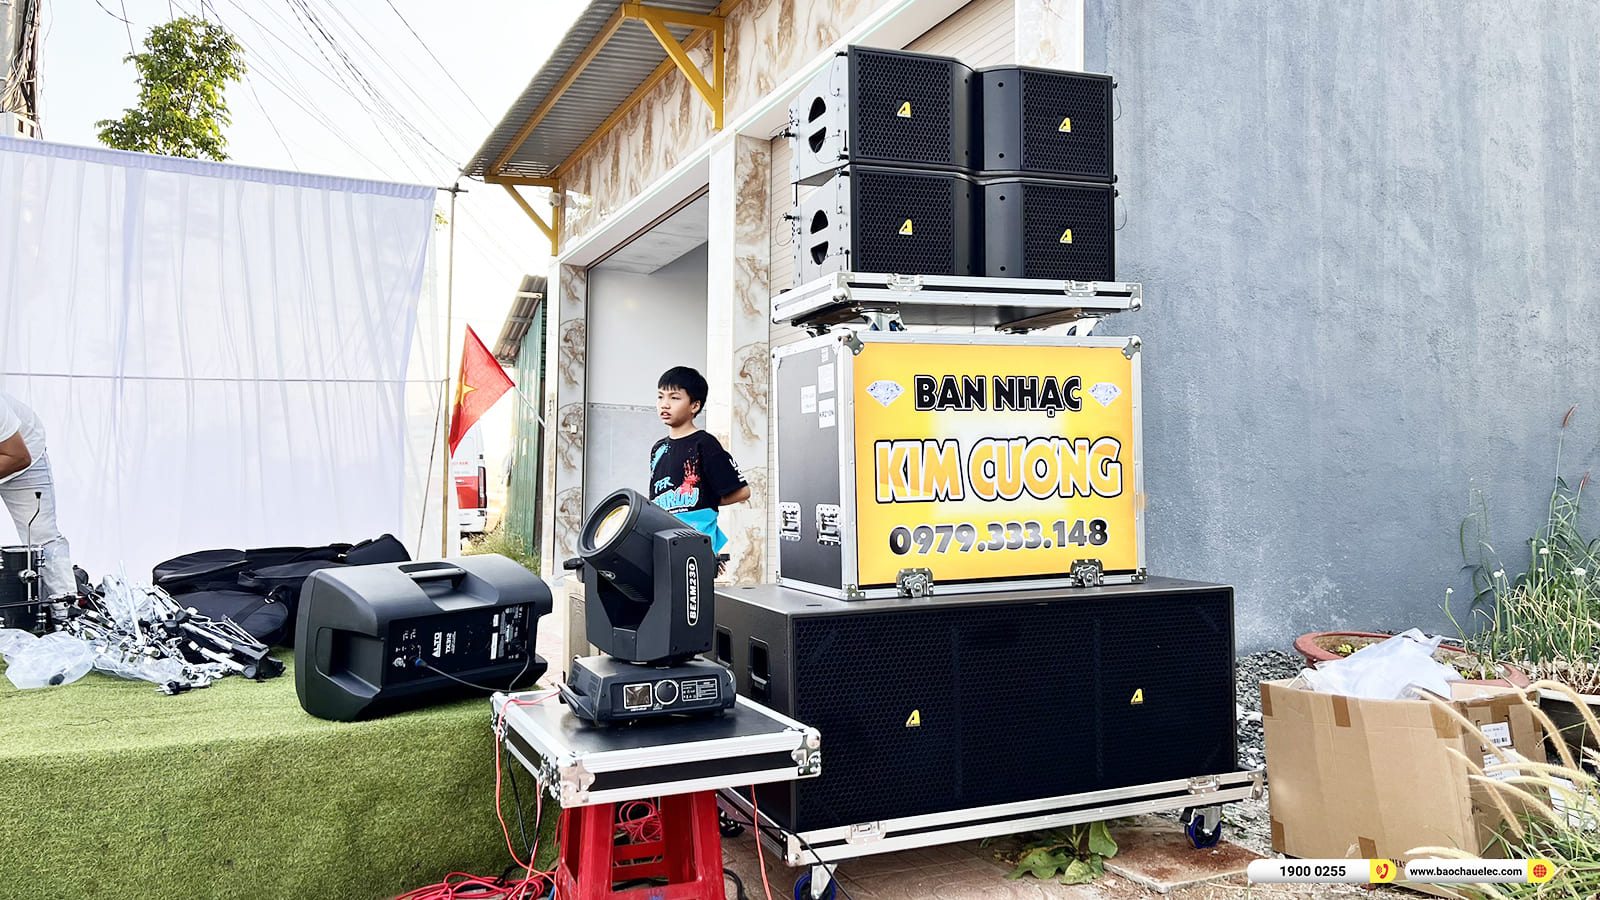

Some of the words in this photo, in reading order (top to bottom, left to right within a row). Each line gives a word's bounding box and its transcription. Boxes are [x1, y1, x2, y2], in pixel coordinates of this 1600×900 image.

[914, 375, 986, 411] BAN
[993, 376, 1082, 418] NHẠC
[875, 439, 964, 503] KIM
[968, 437, 1122, 501] CƯƠNG
[889, 519, 1108, 555] 0979.333.148
[689, 563, 697, 619] BEAM230
[432, 632, 441, 657] ALTO
